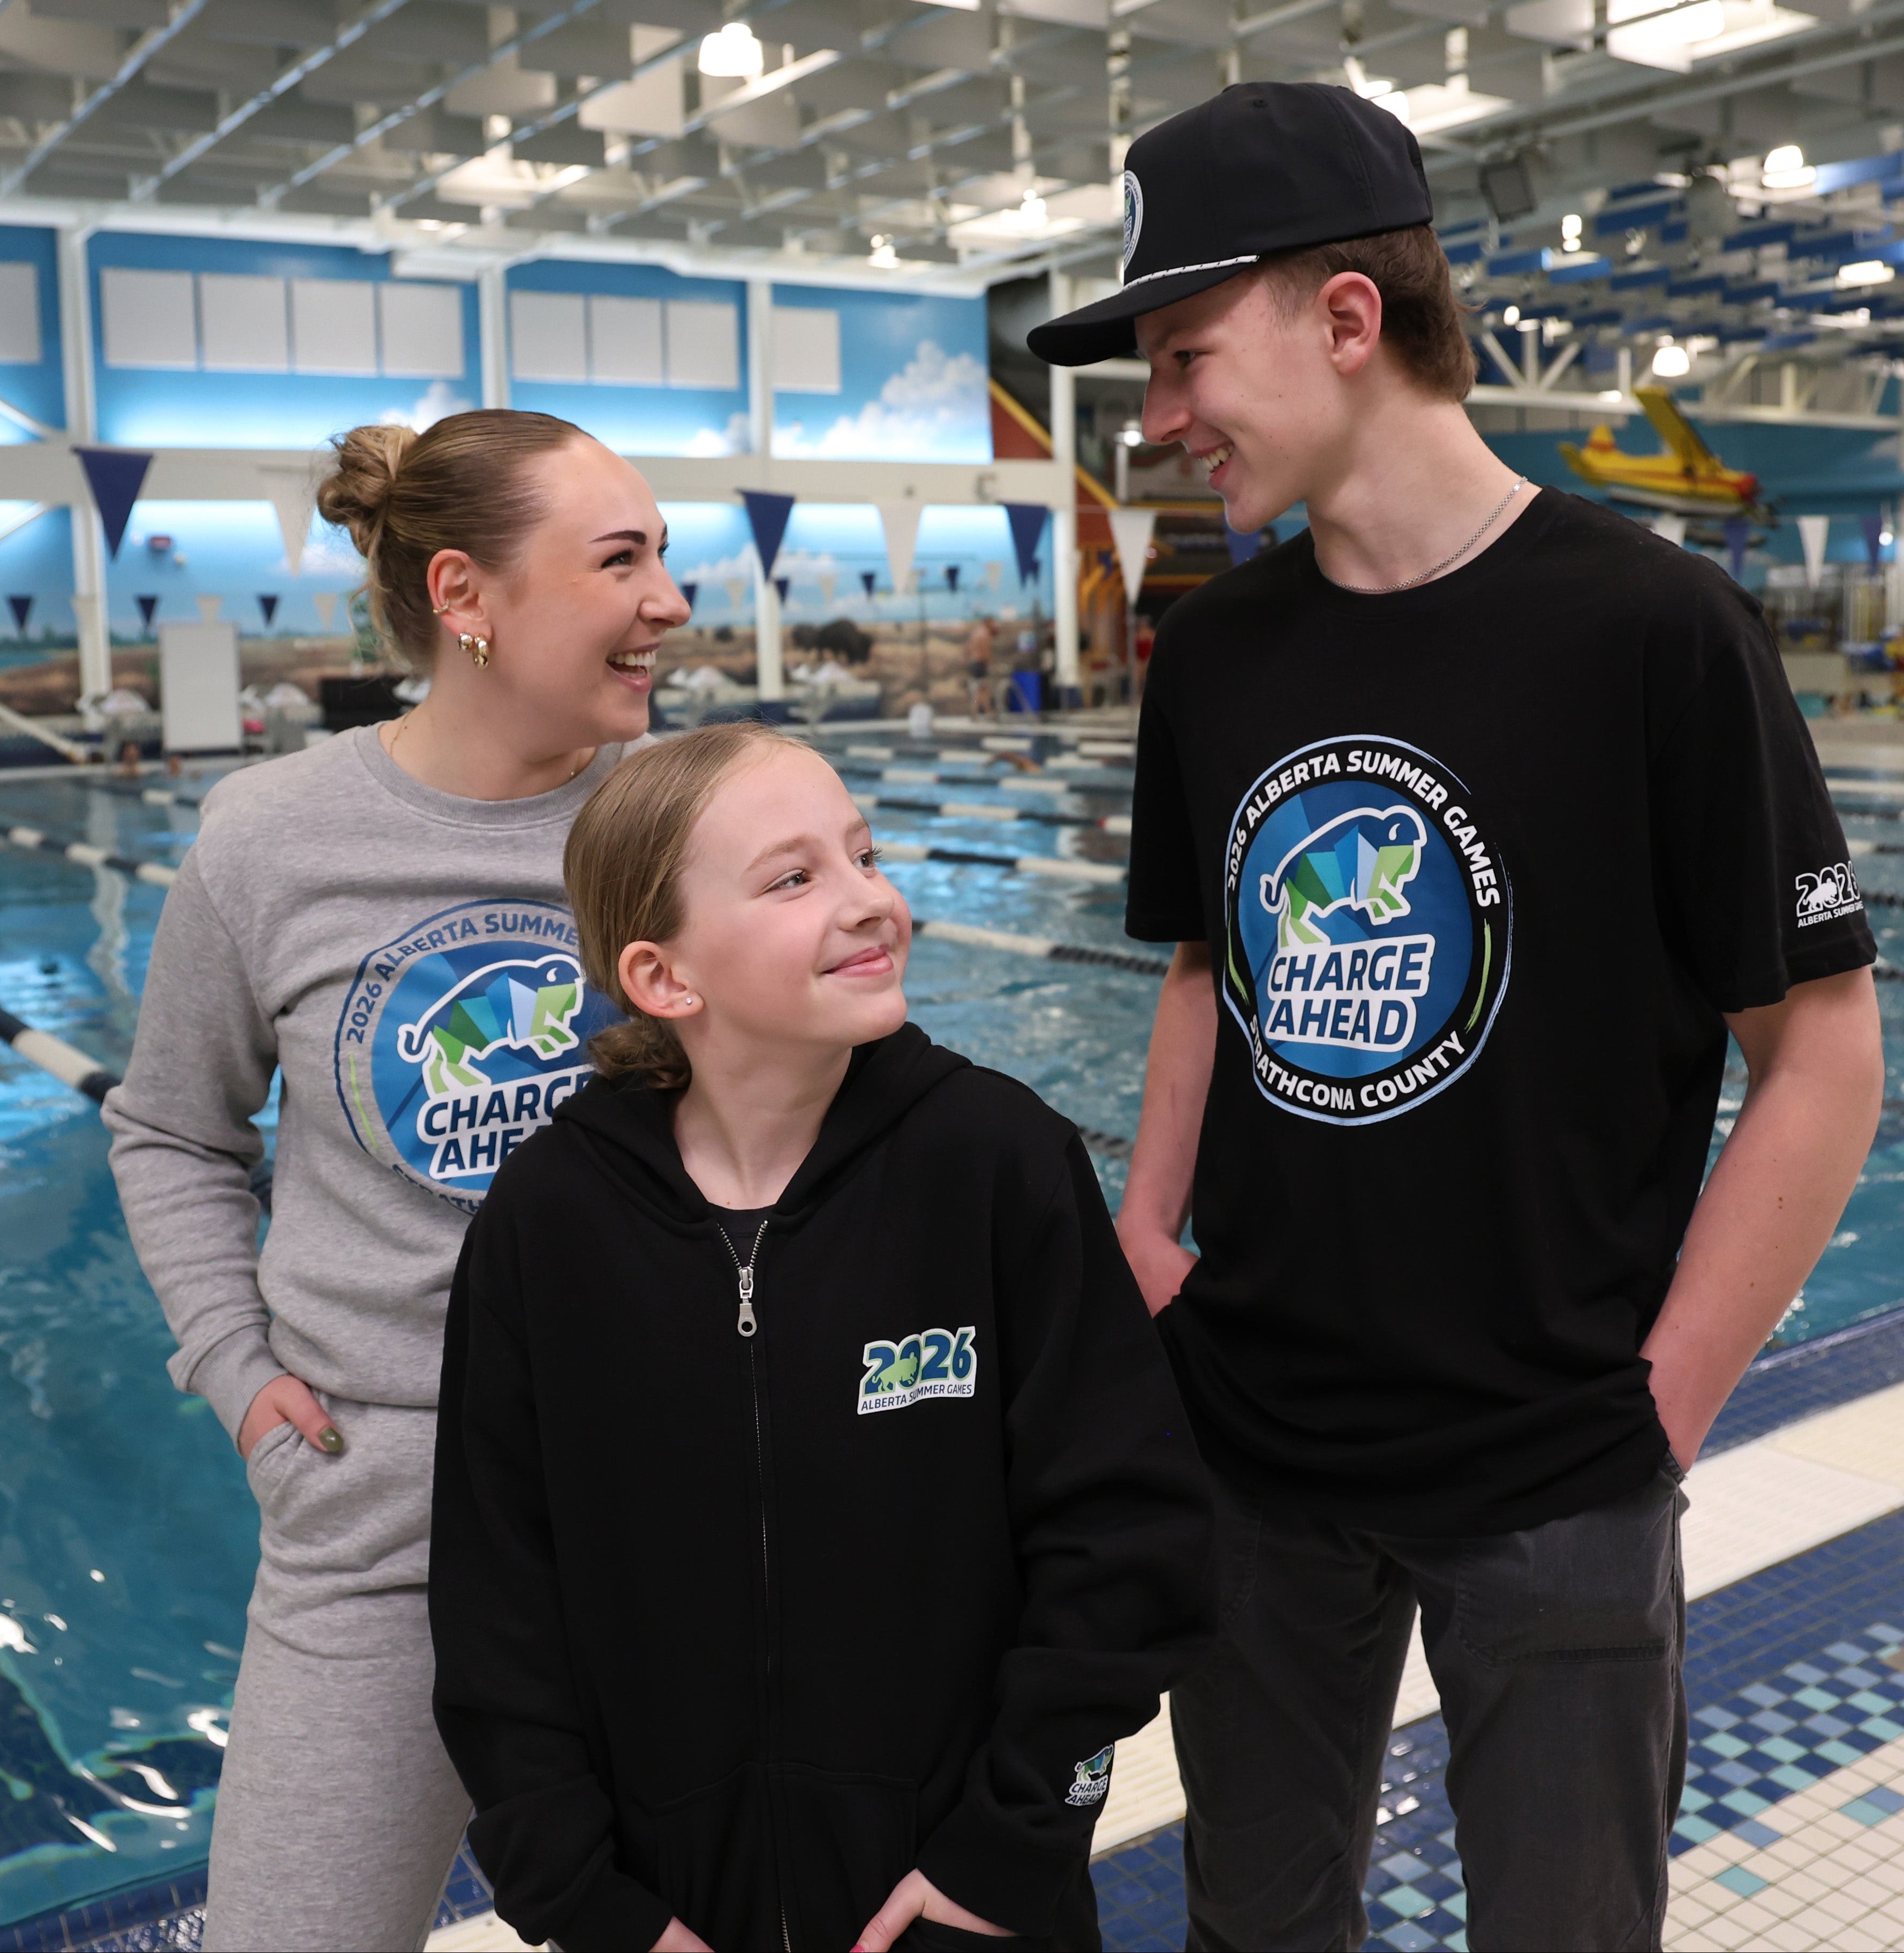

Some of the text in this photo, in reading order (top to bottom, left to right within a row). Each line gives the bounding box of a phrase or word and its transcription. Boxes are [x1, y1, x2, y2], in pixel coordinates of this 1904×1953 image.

[1228, 750, 1501, 907] 2026 ALBERTA SUMMER GAMES
[1797, 911, 1833, 928] ALBERTA
[346, 913, 579, 1044] 2026 ALBERTA SUMME
[1271, 942, 1428, 992] CHARGE
[1268, 998, 1408, 1046] AHEAD
[1249, 1013, 1465, 1110] STRATHCONA COUNTY
[437, 1125, 546, 1173] AHE
[863, 1330, 973, 1396] 2026
[861, 1384, 972, 1412] ALBERTA SUMMER GAMES
[1067, 1792, 1101, 1805] AHEAD
[1071, 1777, 1107, 1793] CHARGE
